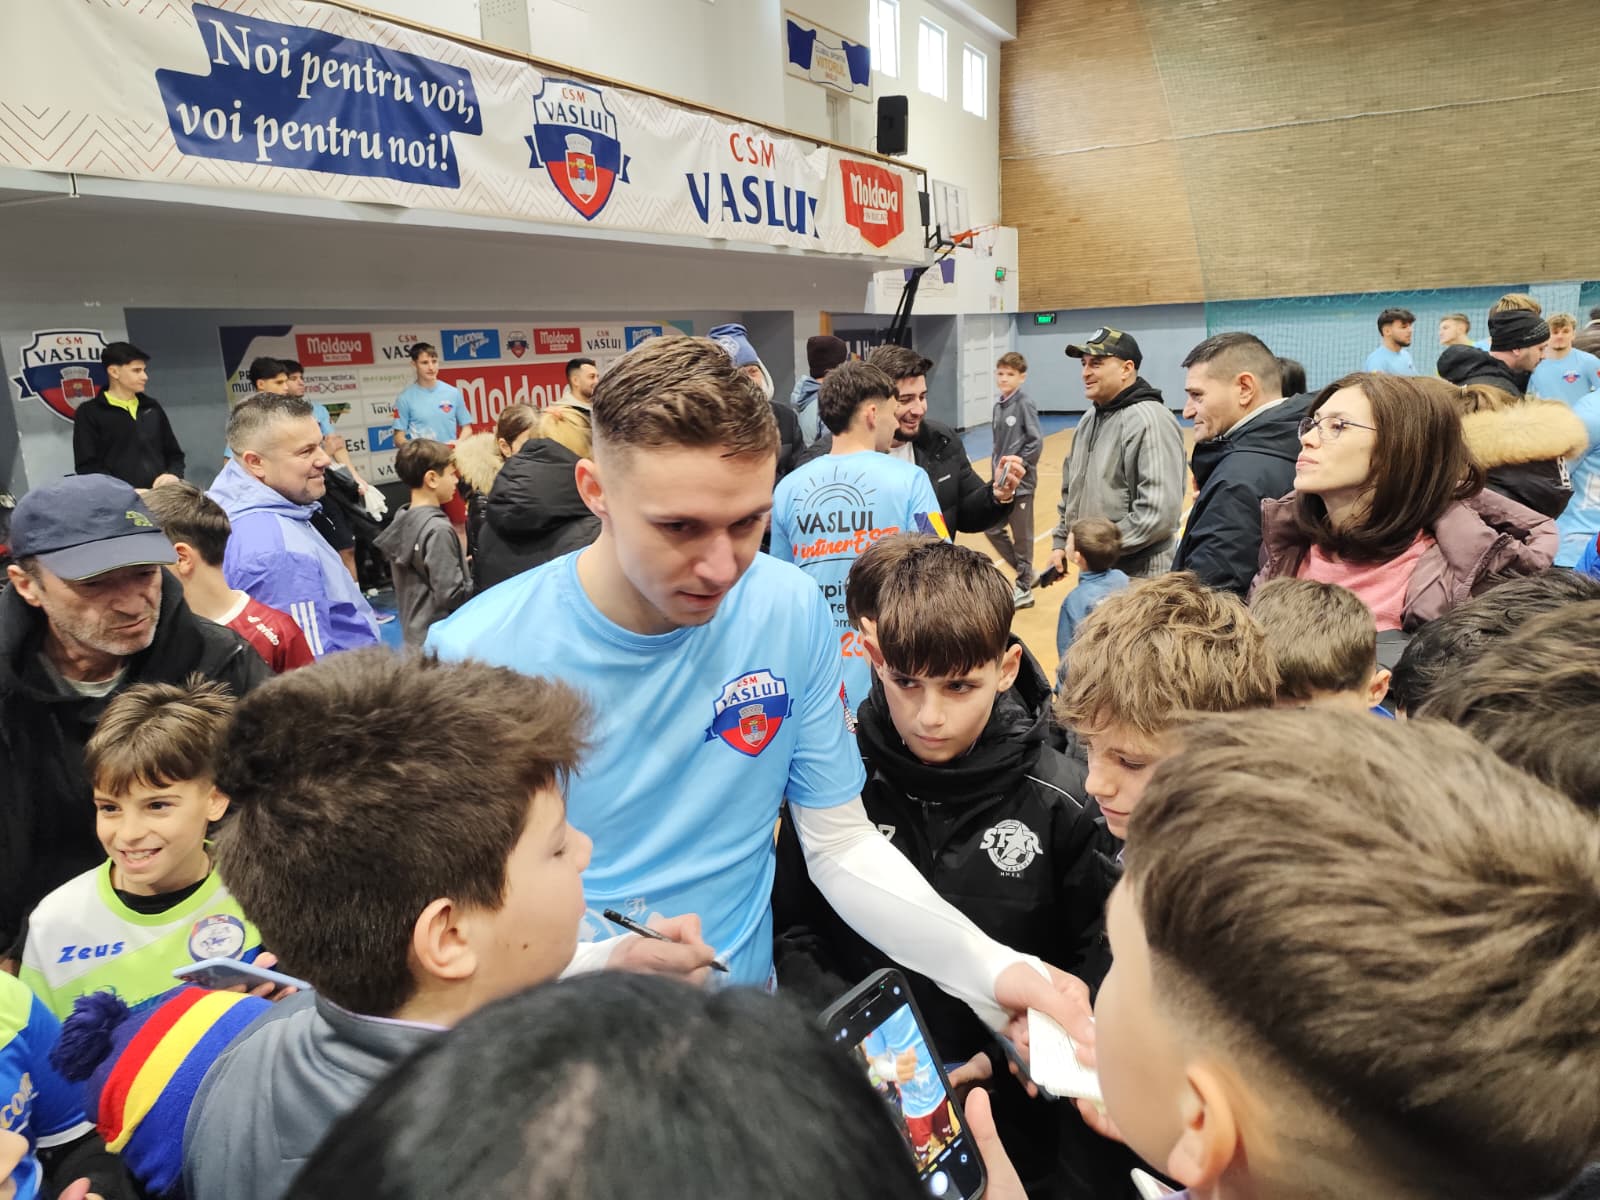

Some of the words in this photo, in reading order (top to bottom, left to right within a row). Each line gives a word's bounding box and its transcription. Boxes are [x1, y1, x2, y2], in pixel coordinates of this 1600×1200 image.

[208, 19, 292, 78] Noi
[297, 52, 414, 103] pentru
[419, 79, 474, 124] voi,
[562, 87, 586, 104] CSM
[541, 101, 609, 133] VASLUI
[176, 99, 243, 143] voi
[253, 113, 384, 162] pentru
[388, 133, 449, 171] noi!
[729, 132, 776, 169] CSM
[685, 171, 820, 240] VASLUI
[56, 336, 83, 345] CSM
[306, 336, 363, 354] Moldova
[586, 338, 622, 351] VASLUI
[34, 346, 105, 364] VASLU
[382, 344, 413, 361] VAS
[796, 510, 873, 535] VASLUI
[56, 941, 126, 964] Zeus
